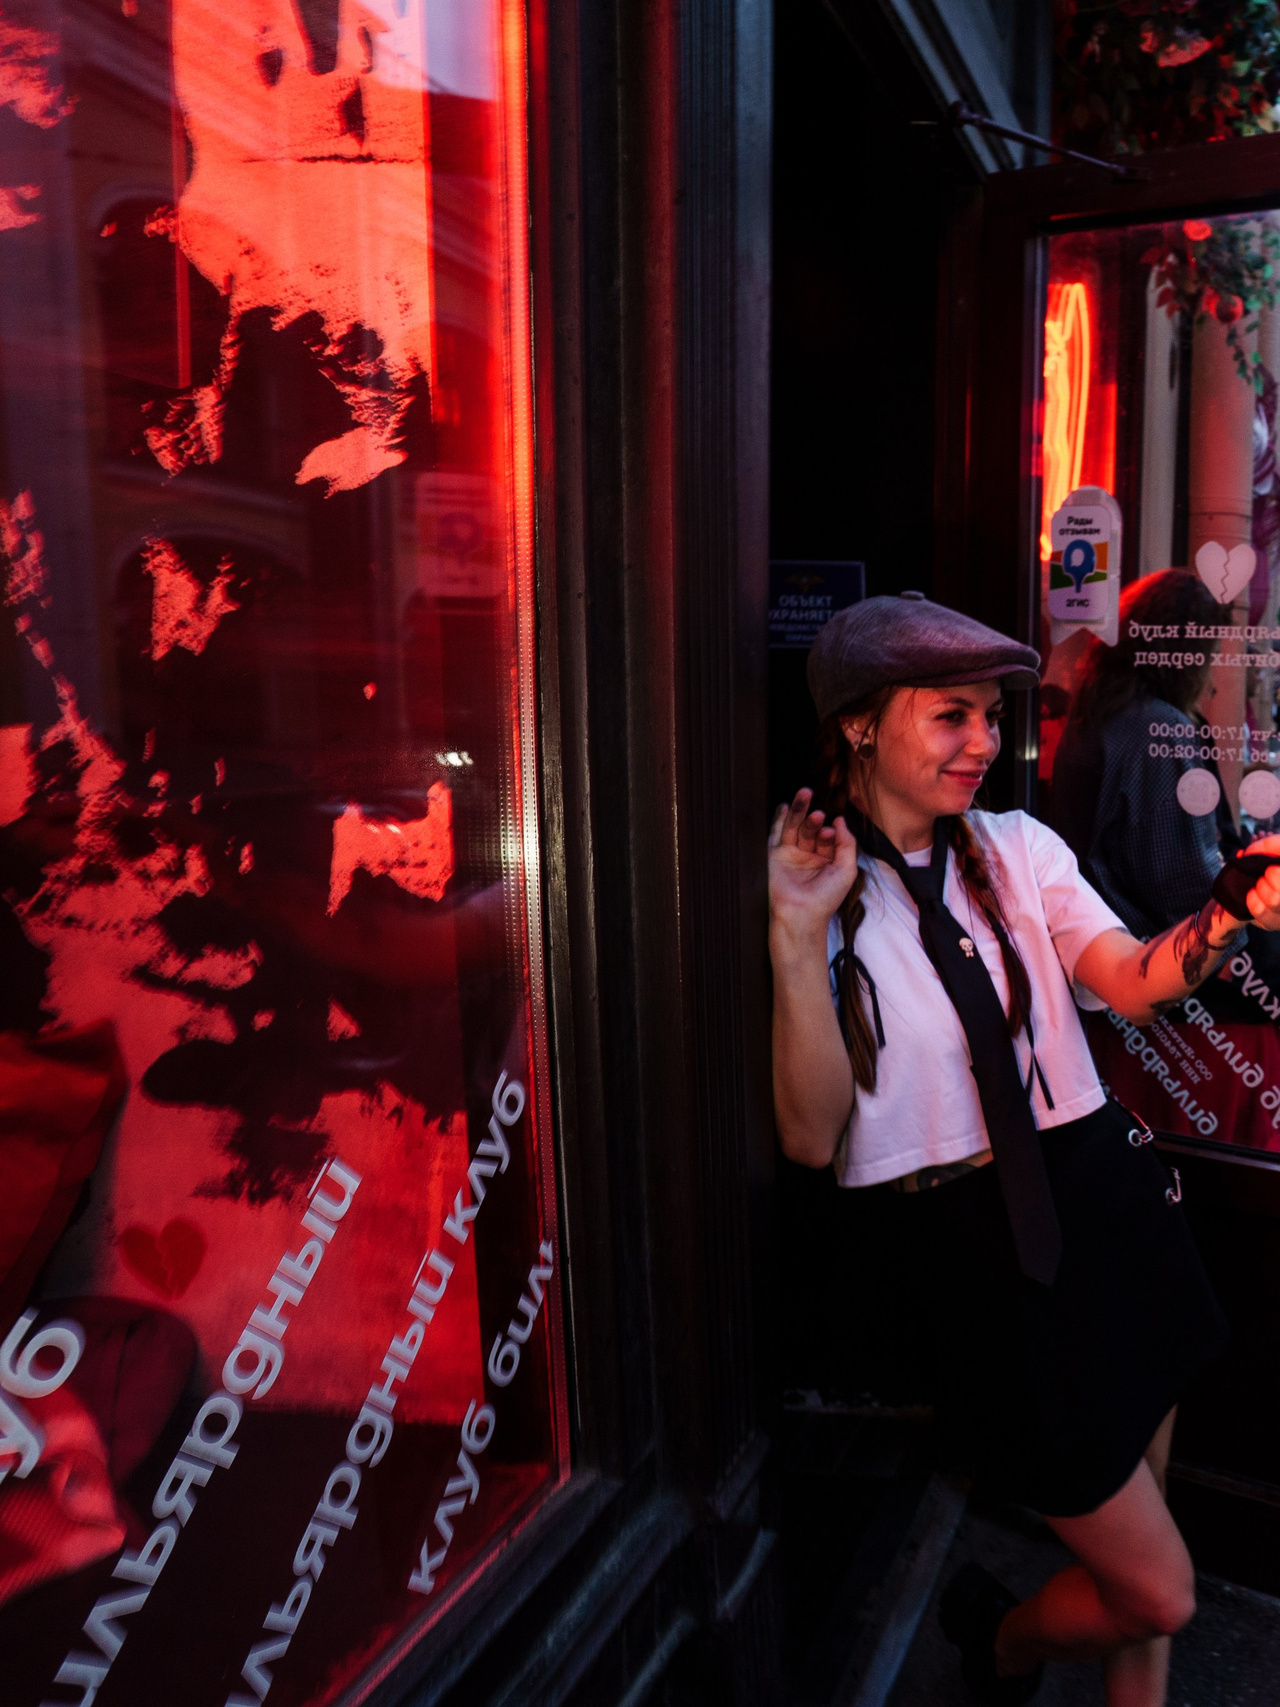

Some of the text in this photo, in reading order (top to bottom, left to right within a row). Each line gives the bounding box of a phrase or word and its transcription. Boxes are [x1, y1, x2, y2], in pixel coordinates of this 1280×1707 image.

[1066, 516, 1093, 526] Рады
[1059, 528, 1101, 536] отзывам
[778, 594, 832, 607] ОБЪЕКТ
[1065, 599, 1090, 608] 2ГИС
[769, 609, 840, 621] ХРАНЯЕТ
[224, 1069, 526, 1707] льярдный клуб
[0, 1306, 86, 1485] уб
[407, 1399, 496, 1596] клуб
